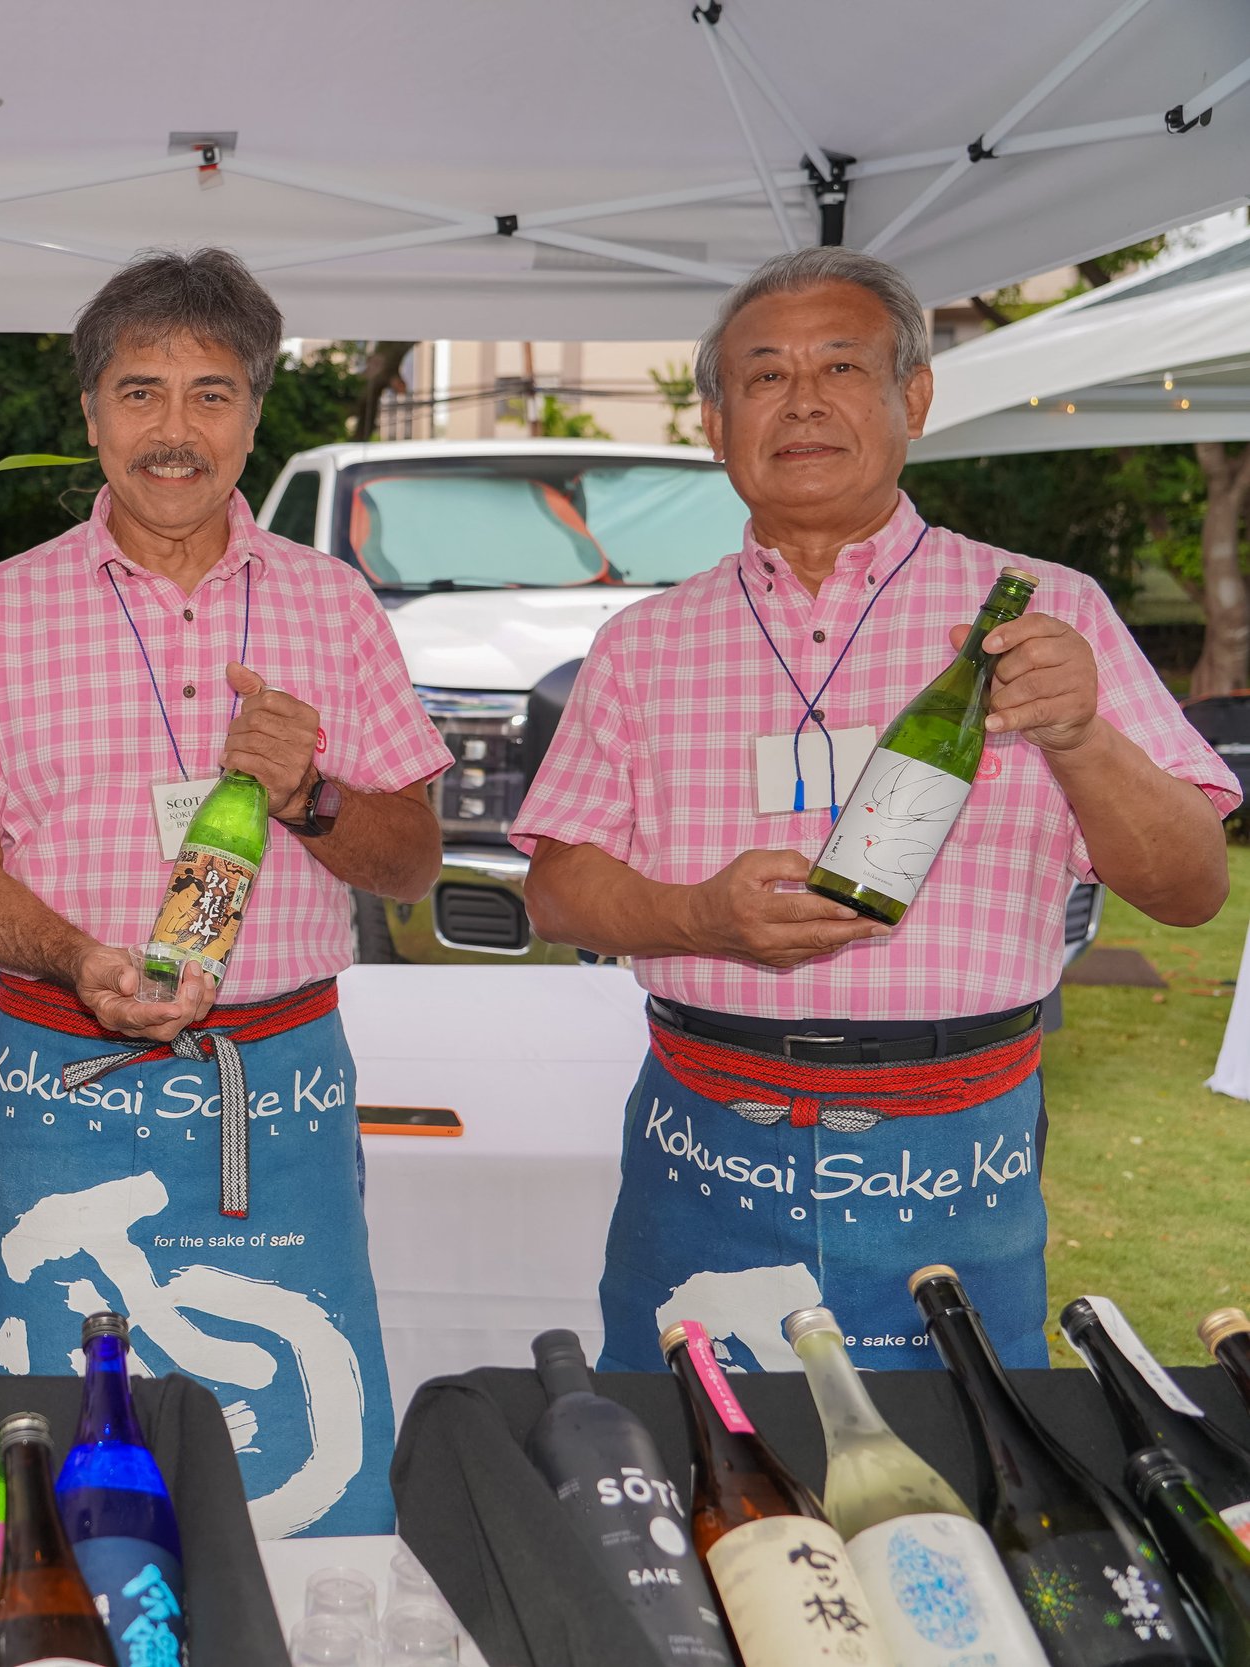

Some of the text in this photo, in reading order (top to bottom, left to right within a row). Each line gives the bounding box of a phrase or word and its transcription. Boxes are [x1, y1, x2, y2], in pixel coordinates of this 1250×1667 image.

[294, 1065, 346, 1113] Kai
[5, 1105, 319, 1141] HONOLLU
[645, 1097, 1031, 1200] Kokusai Sake Kai
[668, 1168, 998, 1223] HONOLULU
[153, 1232, 305, 1247] for the sake of sake
[862, 1333, 906, 1347] sake
[628, 1568, 682, 1586] SAKE
